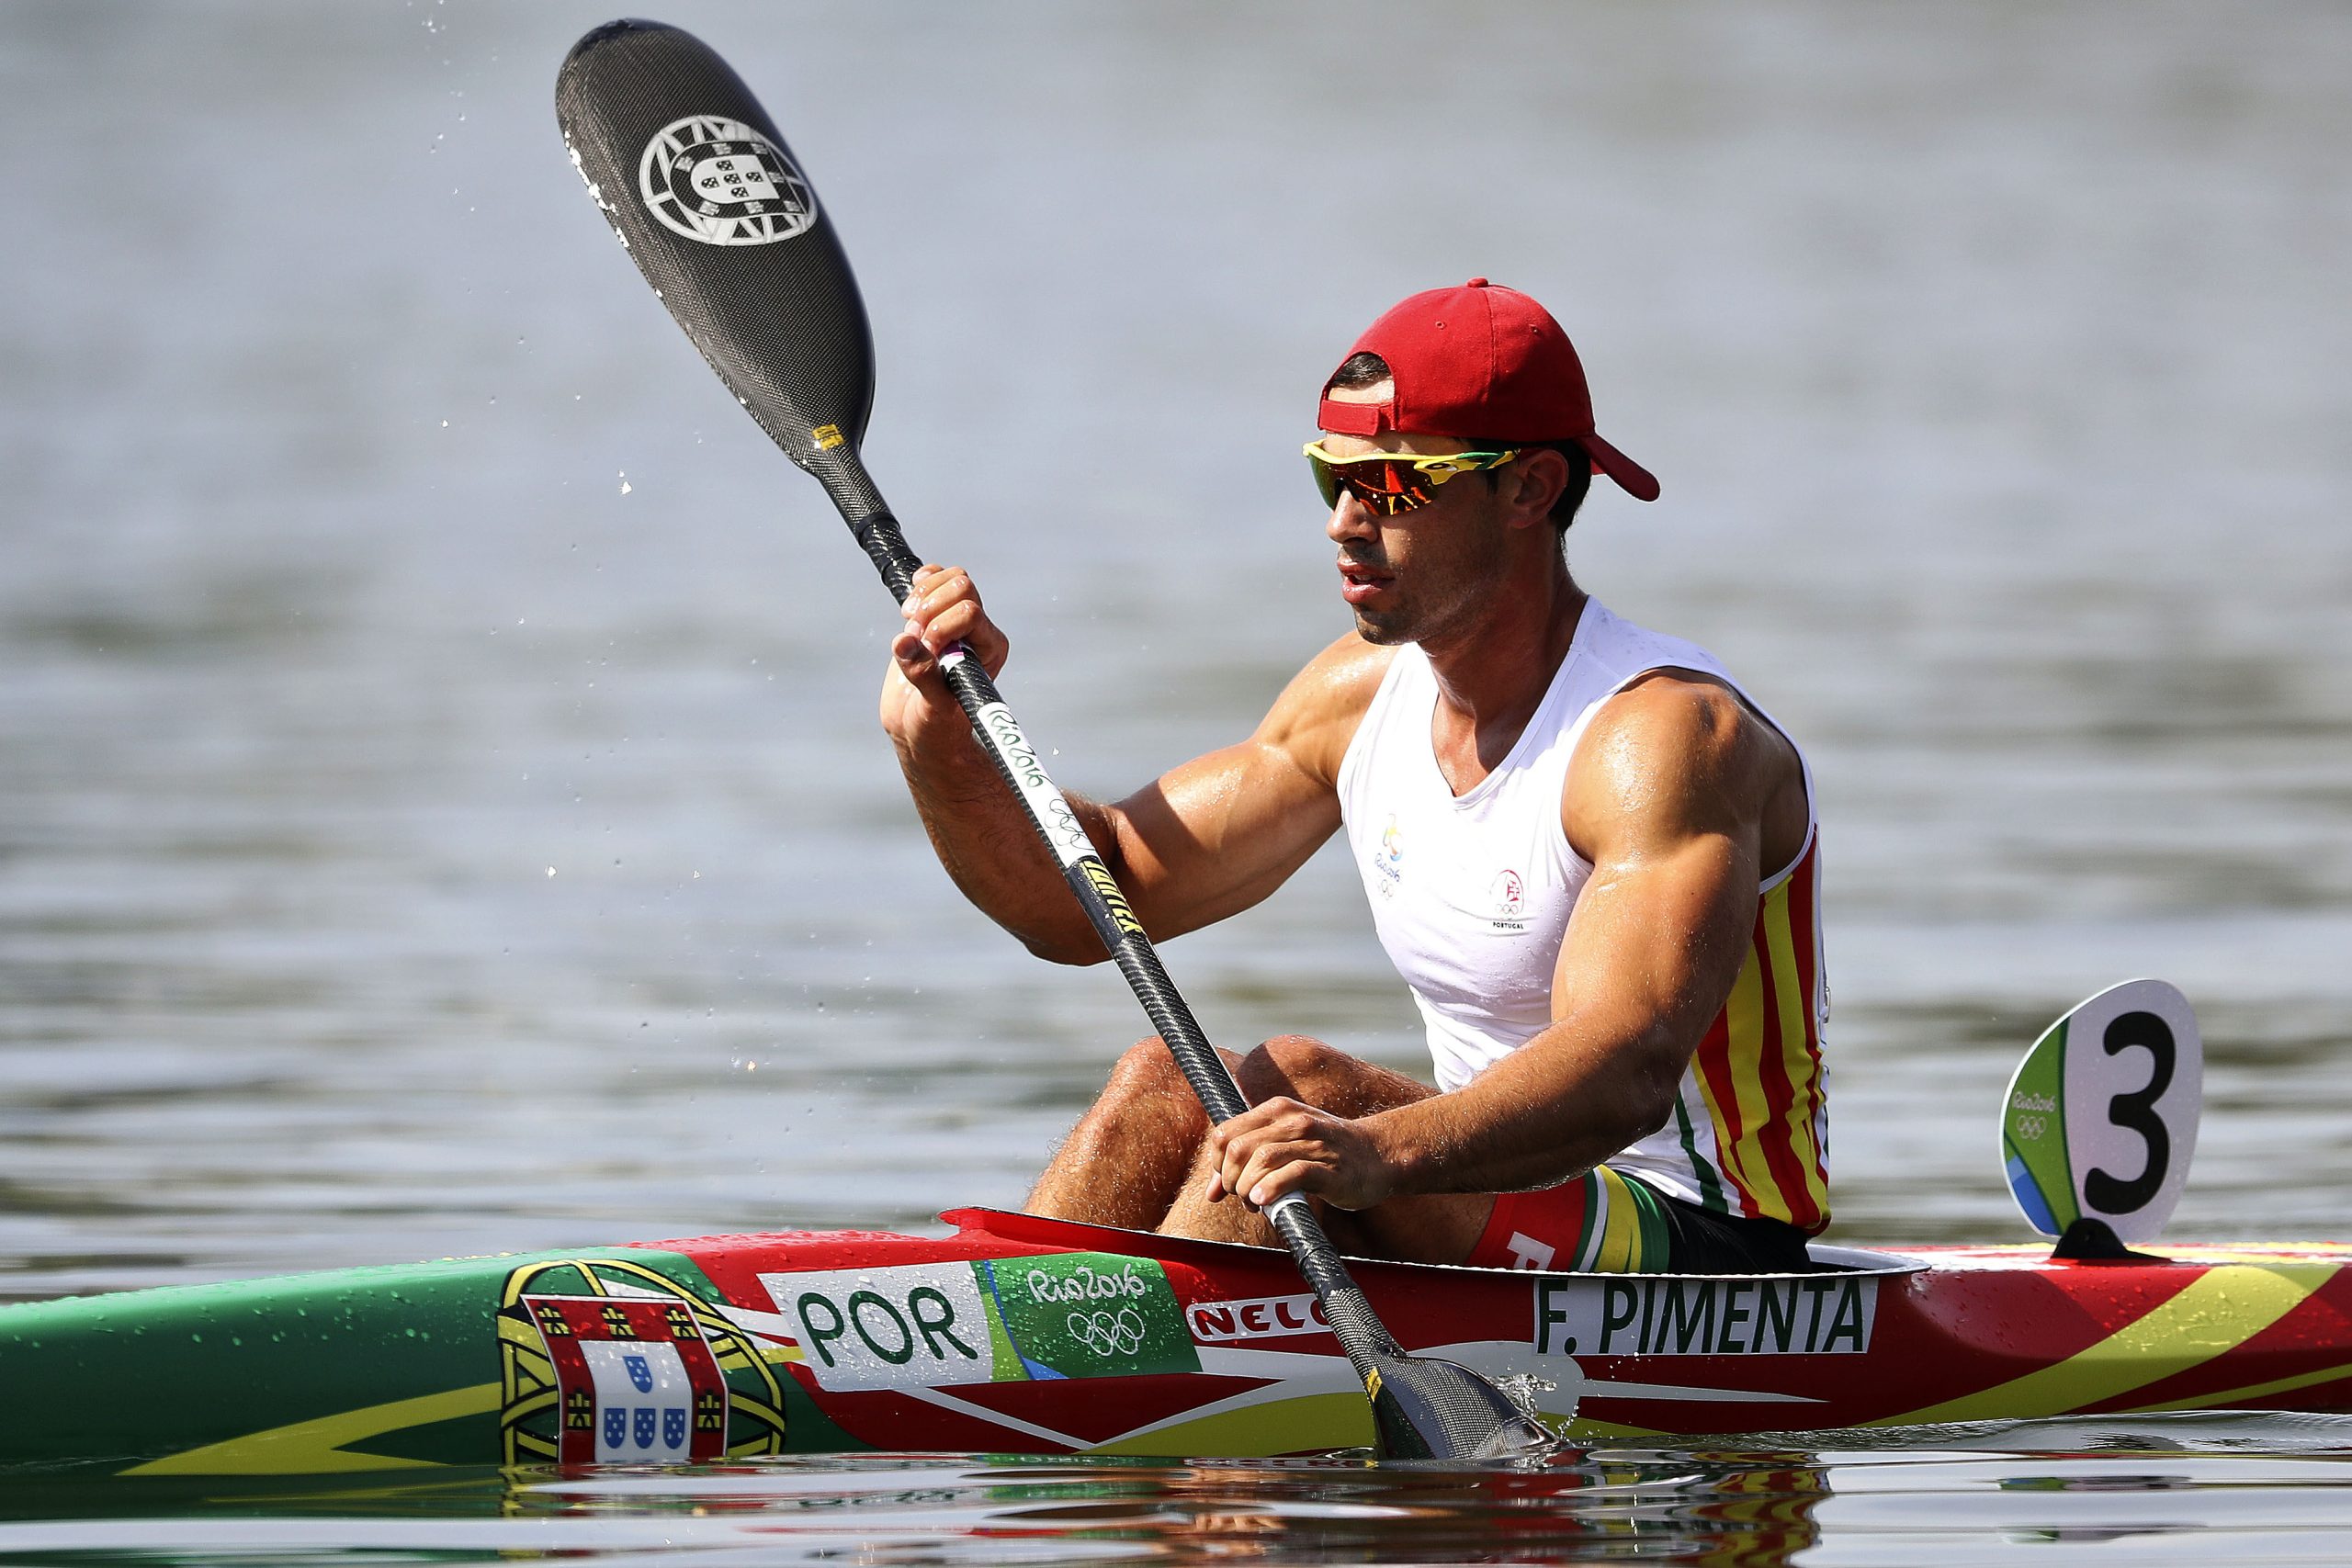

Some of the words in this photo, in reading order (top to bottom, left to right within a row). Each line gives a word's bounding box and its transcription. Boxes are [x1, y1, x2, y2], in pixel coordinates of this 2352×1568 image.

[986, 709, 1054, 789] Rio2016
[1493, 921, 1524, 930] PORTUGAL
[2084, 1011, 2177, 1215] 3
[1027, 1263, 1146, 1303] Rio2016
[1537, 1278, 1577, 1355] F.
[1598, 1278, 1864, 1355] PIMENTA
[797, 1286, 978, 1368] POR
